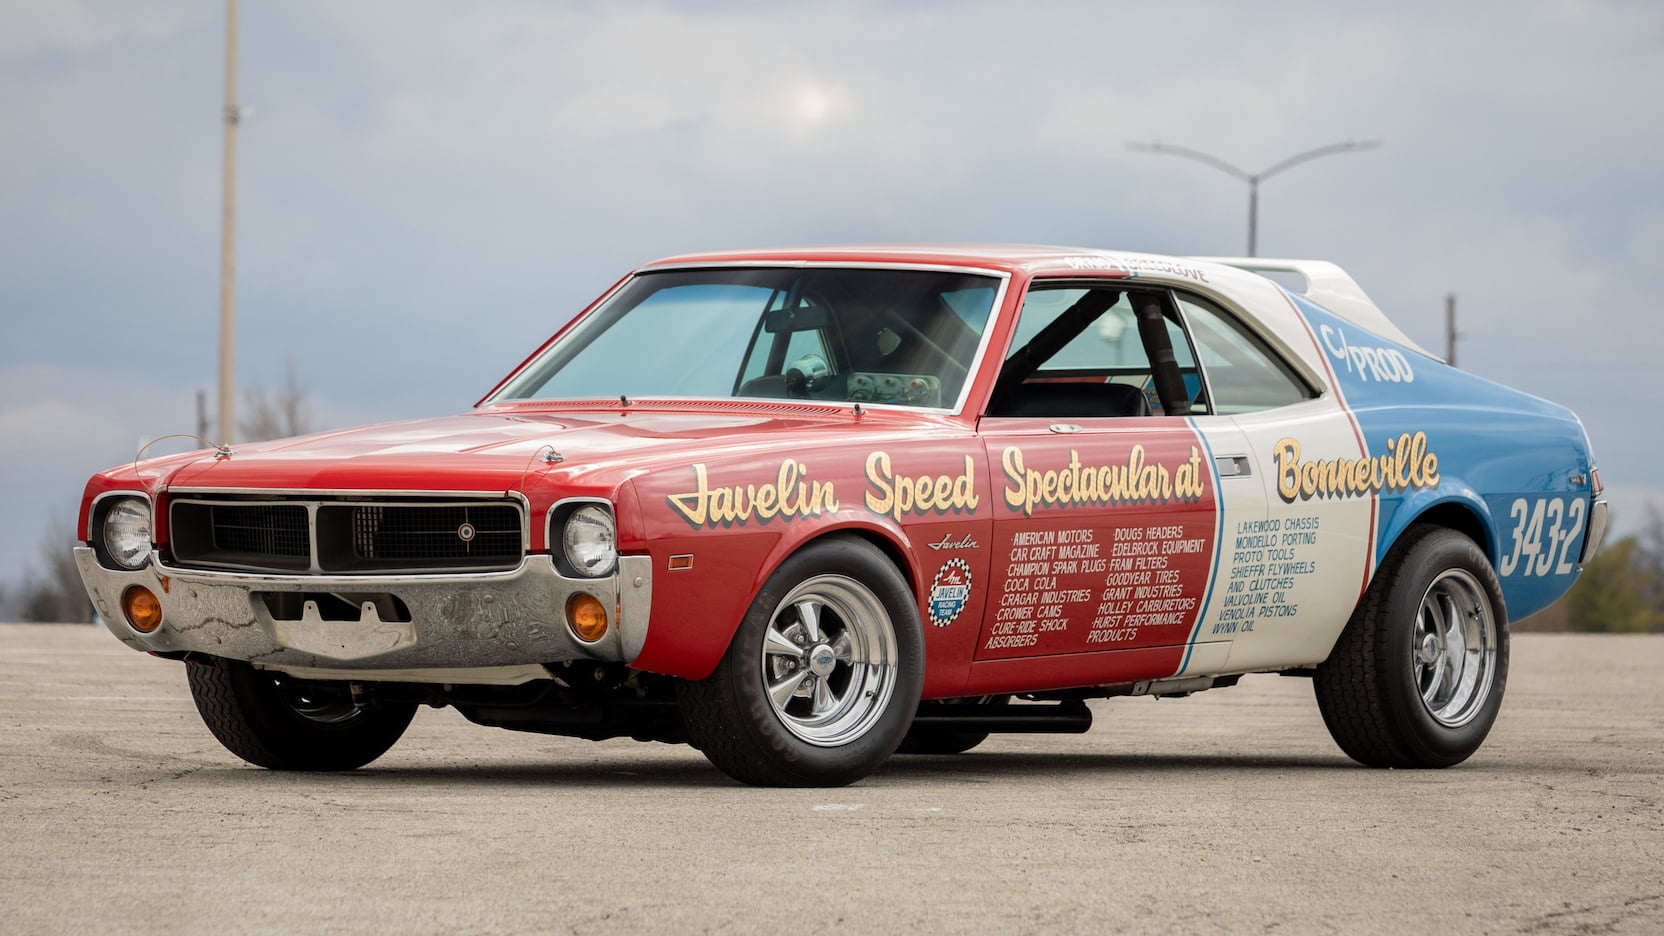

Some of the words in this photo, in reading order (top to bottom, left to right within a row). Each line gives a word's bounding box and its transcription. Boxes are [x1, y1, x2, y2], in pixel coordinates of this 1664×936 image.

[1320, 324, 1414, 382] C/PROD
[666, 459, 839, 530] Javelin
[864, 451, 979, 524] Speed
[1001, 444, 1170, 518] Spectacular
[1177, 445, 1204, 500] at
[1273, 431, 1440, 503] Bonneville
[1114, 528, 1143, 541] DOUGS
[1146, 526, 1183, 539] HEADERS
[1238, 520, 1281, 534] LAKEWOOD
[1285, 517, 1320, 530] CHASSIS
[927, 534, 980, 550] Javelin
[1014, 532, 1055, 545] AMERICAN
[1057, 530, 1093, 544] MOTORS
[1236, 535, 1277, 549] MONDELLO
[1282, 532, 1316, 546] PORTING
[1500, 498, 1586, 577] 343-2
[1010, 548, 1027, 561] CAR
[1030, 546, 1056, 560] CRAFT
[1059, 544, 1099, 559] MAGAZINE
[1112, 542, 1159, 556] EDELBROCK
[1162, 539, 1205, 554] EQUIPMENT
[1110, 559, 1133, 571] FRAM
[1135, 557, 1168, 569] FILTERS
[1233, 551, 1262, 564] PROTO
[1268, 549, 1295, 561] TOOLS
[1008, 562, 1049, 576] CHAMPION
[1052, 561, 1078, 574] SPARK
[1081, 559, 1106, 573] PLUGS
[1268, 562, 1315, 576] FLYWHEELS
[1004, 579, 1028, 592] COCA
[1034, 577, 1057, 590] COLA
[1107, 573, 1150, 586] GOODYEAR
[1156, 570, 1179, 583] TIRES
[1227, 581, 1245, 593] AND
[1249, 577, 1294, 591] CLUTCHES
[936, 587, 965, 598] JAVELIN
[1002, 593, 1037, 606] CRAGAR
[1041, 590, 1091, 604] INDUSTRIES
[1102, 588, 1130, 601] GRANT
[1134, 585, 1183, 599] INDUSTRIES
[1224, 593, 1269, 607] VALVOLINE
[1272, 592, 1285, 603] OIL
[997, 608, 1032, 620] CROWER
[1037, 605, 1063, 618] CAMS
[1099, 601, 1131, 615] HOLLEY
[1137, 598, 1195, 612] CARBURETORS
[1219, 607, 1255, 621] VENOLIA
[1258, 605, 1298, 618] PISTONS
[1039, 619, 1069, 631] SHOCK
[1092, 615, 1120, 628] HURST
[1123, 613, 1186, 627] PERFORMANCE
[1213, 622, 1238, 634] WYNN
[1241, 621, 1254, 631] OIL
[985, 634, 1038, 649] ABSORBERS
[1087, 629, 1137, 643] PRODUCTS
